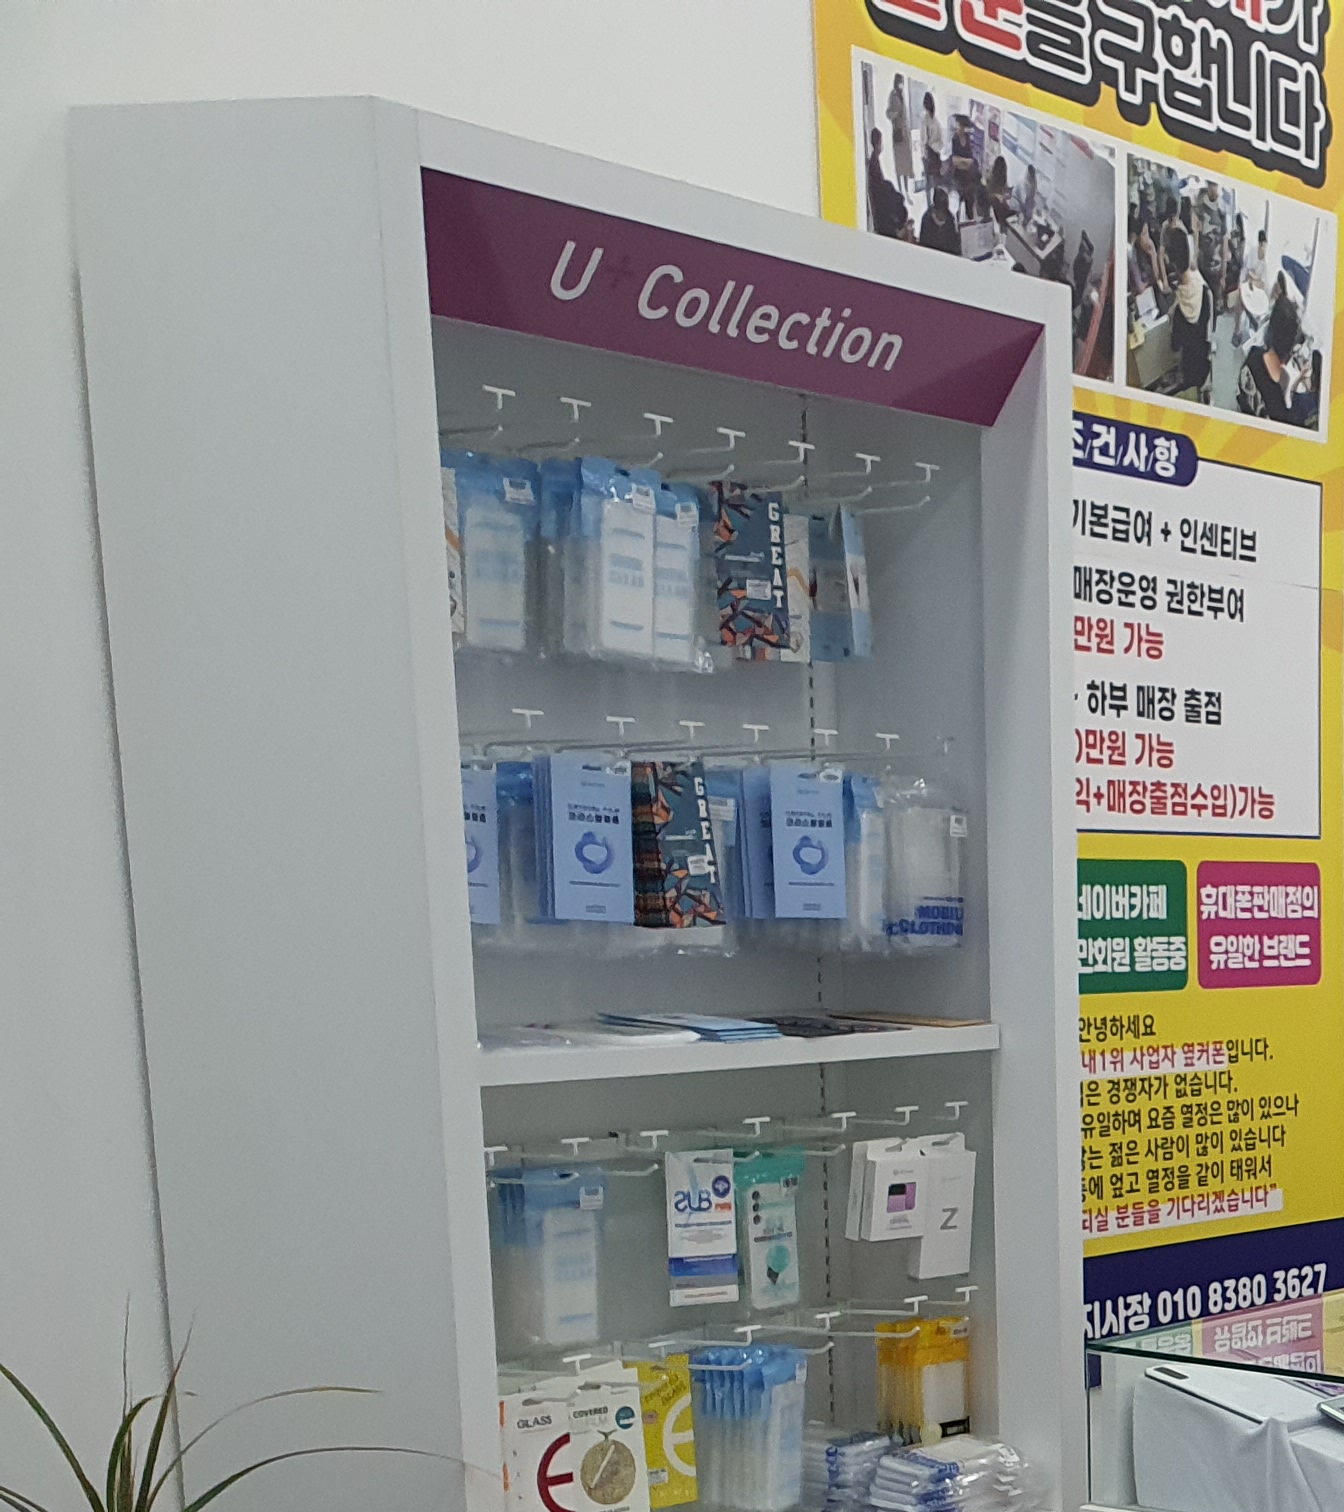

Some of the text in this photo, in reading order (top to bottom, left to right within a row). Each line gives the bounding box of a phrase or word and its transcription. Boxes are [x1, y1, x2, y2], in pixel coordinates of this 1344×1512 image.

[550, 241, 903, 371] U Collection
[1179, 519, 1257, 562] 인센티브
[1073, 566, 1245, 622] 매장운영 권한부여
[1123, 621, 1164, 659] 가능
[1087, 680, 1222, 725] 하부 매장 출점
[1135, 732, 1175, 768] 가능
[1201, 885, 1318, 920] 휴대폰판매점의
[1133, 937, 1186, 972] 활동중
[1210, 935, 1311, 970] 유일한 브랜드
[1079, 1015, 1156, 1043] 안녕하세요
[1130, 1044, 1176, 1071] 사업자
[1182, 1038, 1273, 1067] 옆커폰입니다.
[1107, 1070, 1237, 1105] 경쟁자가 없습니다.
[1082, 1094, 1299, 1140] 유일하며 요즘 열정은 많이 있으나
[1109, 1125, 1286, 1168] 젊은 사람이 많이 있습니다
[1147, 1164, 1190, 1195] 열정을
[1196, 1160, 1224, 1187] 같이
[1230, 1155, 1272, 1180] 태워서
[940, 1209, 958, 1230] Z
[1115, 1199, 1161, 1229] 분들을
[1158, 1286, 1199, 1324] 010
[1208, 1274, 1266, 1312] 8380
[1274, 1264, 1326, 1299] 3627
